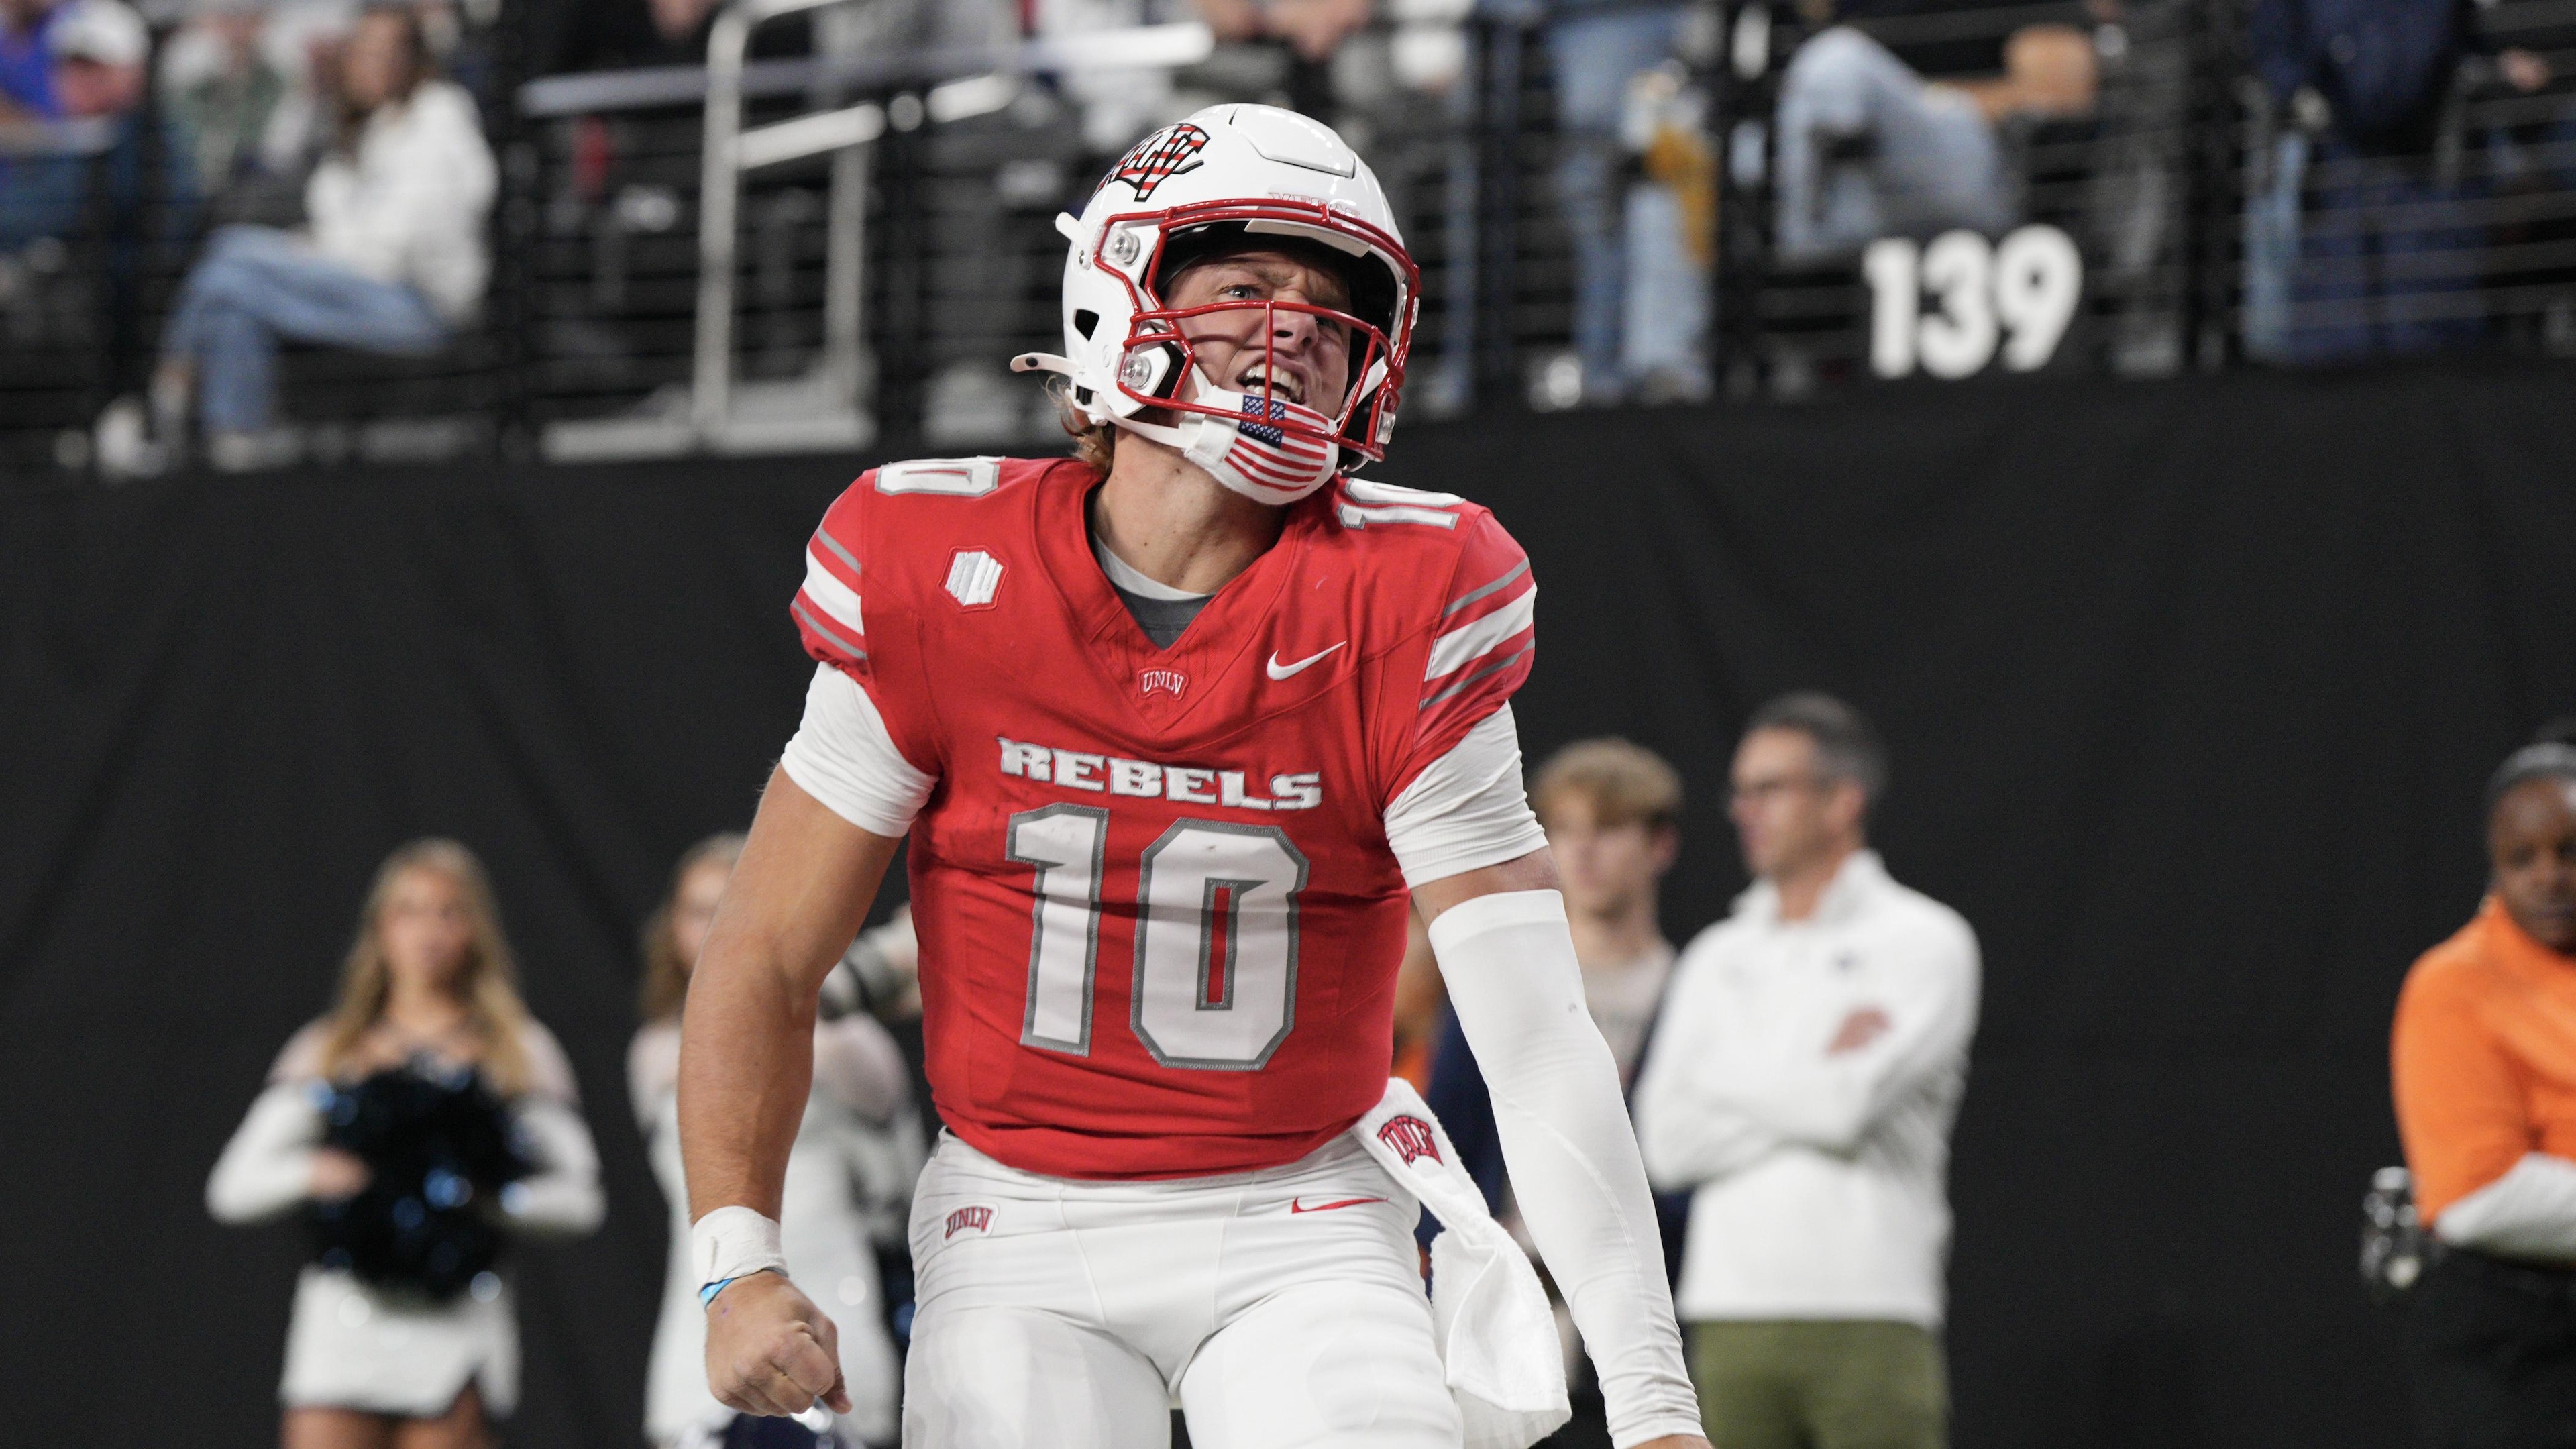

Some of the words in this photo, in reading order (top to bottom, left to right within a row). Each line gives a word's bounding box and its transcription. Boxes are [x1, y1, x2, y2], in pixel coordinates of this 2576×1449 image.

[1862, 225, 2082, 380] 139
[874, 455, 1006, 497] 0
[1143, 670, 1185, 694] UNLV
[996, 736, 1322, 810] REBELS
[1005, 801, 1310, 1071] 10
[945, 1205, 993, 1240] UNLV
